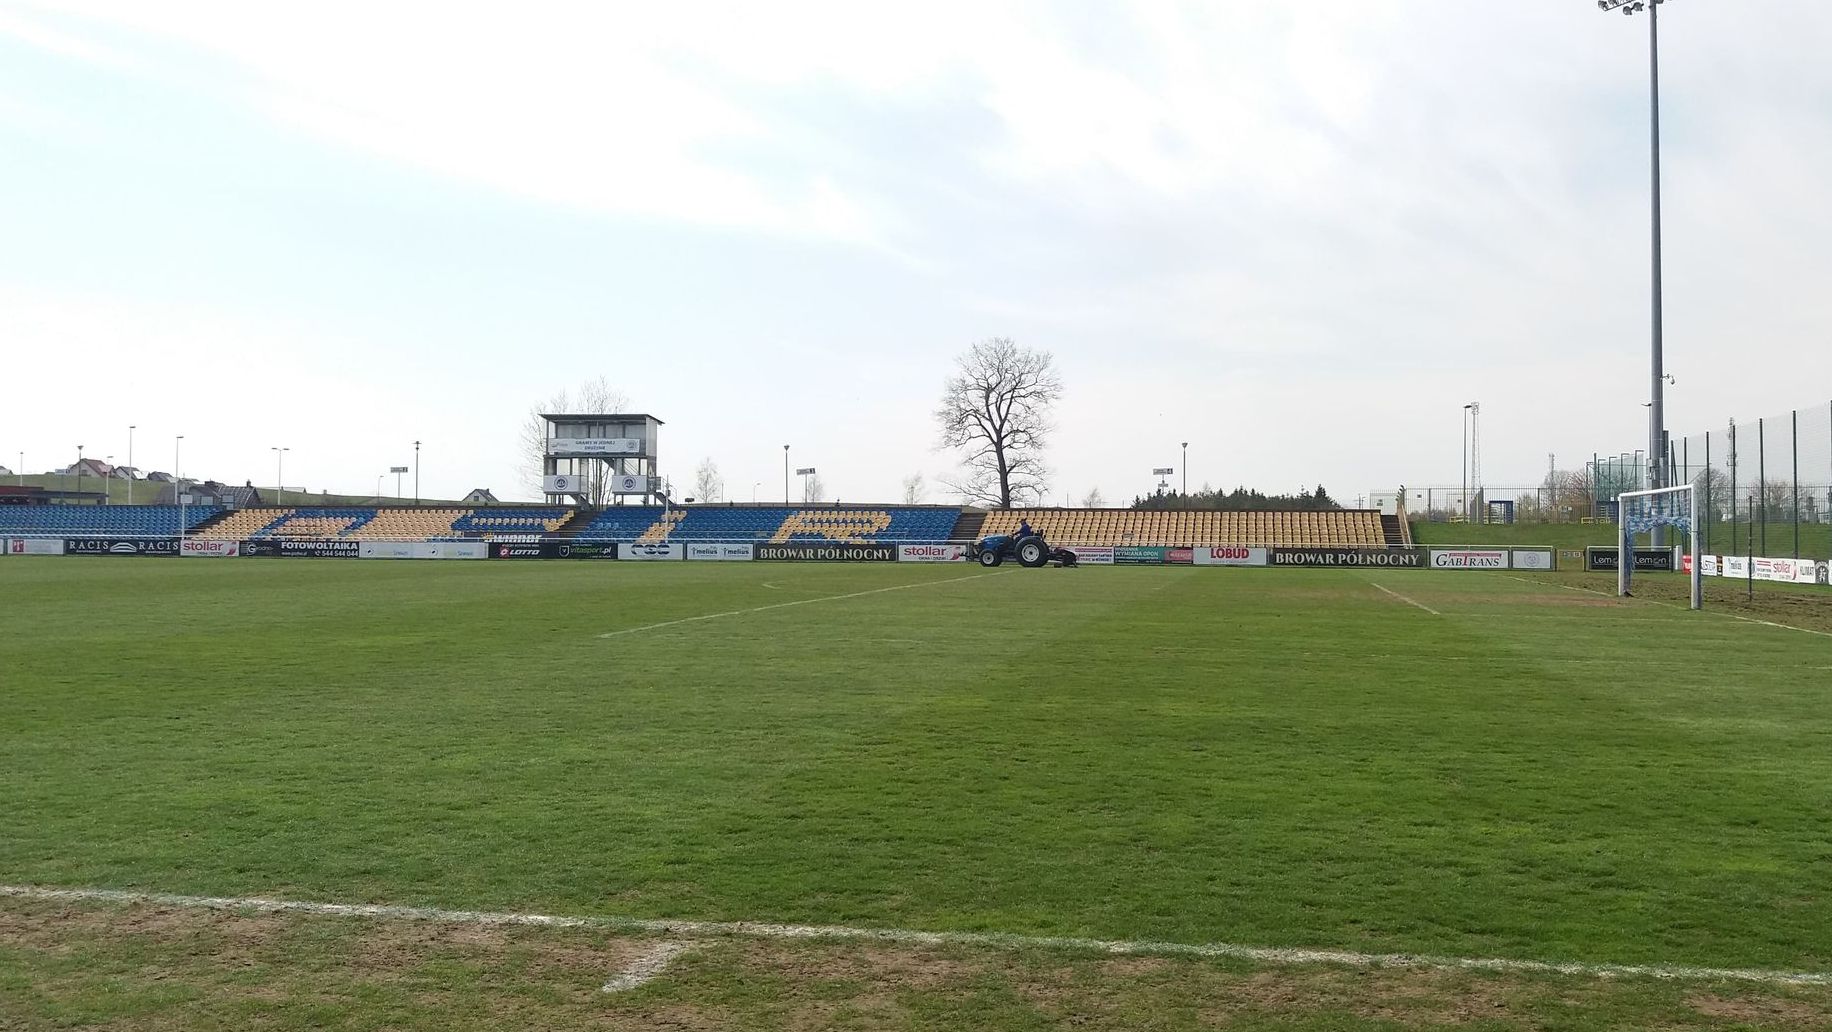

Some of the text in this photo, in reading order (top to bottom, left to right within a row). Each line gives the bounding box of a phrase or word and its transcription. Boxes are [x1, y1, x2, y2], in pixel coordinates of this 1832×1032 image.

[69, 540, 109, 550] RACIS
[139, 541, 179, 550] RACIS
[183, 541, 224, 551] stollar
[281, 541, 358, 550] FOTOWOLTAIKA
[570, 546, 612, 555] vitasport.pl
[760, 546, 892, 560] BROWAR PÓŁNOCNY
[903, 546, 947, 556] stollar
[1210, 548, 1250, 559] LOBUD
[1275, 550, 1420, 566] BROWAR PÓŁNOCNY
